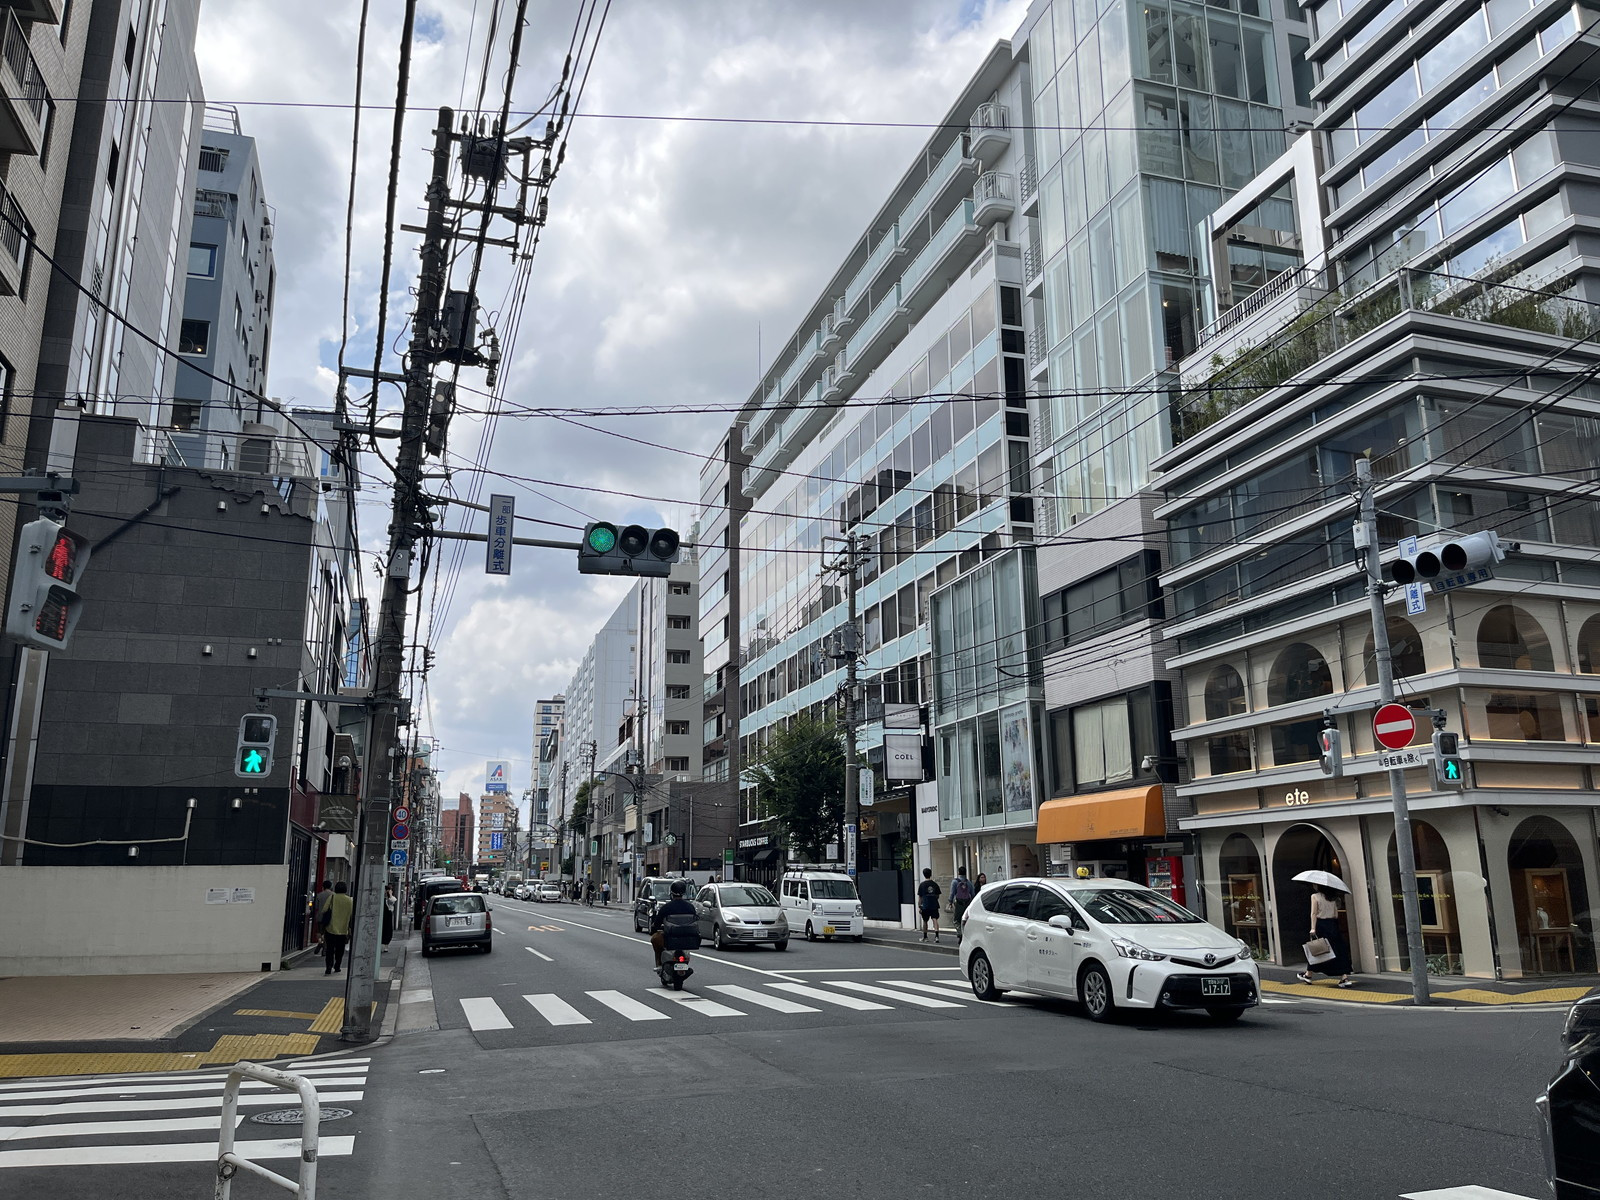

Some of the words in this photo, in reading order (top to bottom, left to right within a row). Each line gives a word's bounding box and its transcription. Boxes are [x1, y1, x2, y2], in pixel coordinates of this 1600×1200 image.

[1435, 568, 1489, 591] 自転車専用
[1285, 788, 1309, 806] ete
[396, 810, 407, 819] 40
[739, 837, 757, 848] STARBUCKS
[756, 836, 769, 846] COFFEE
